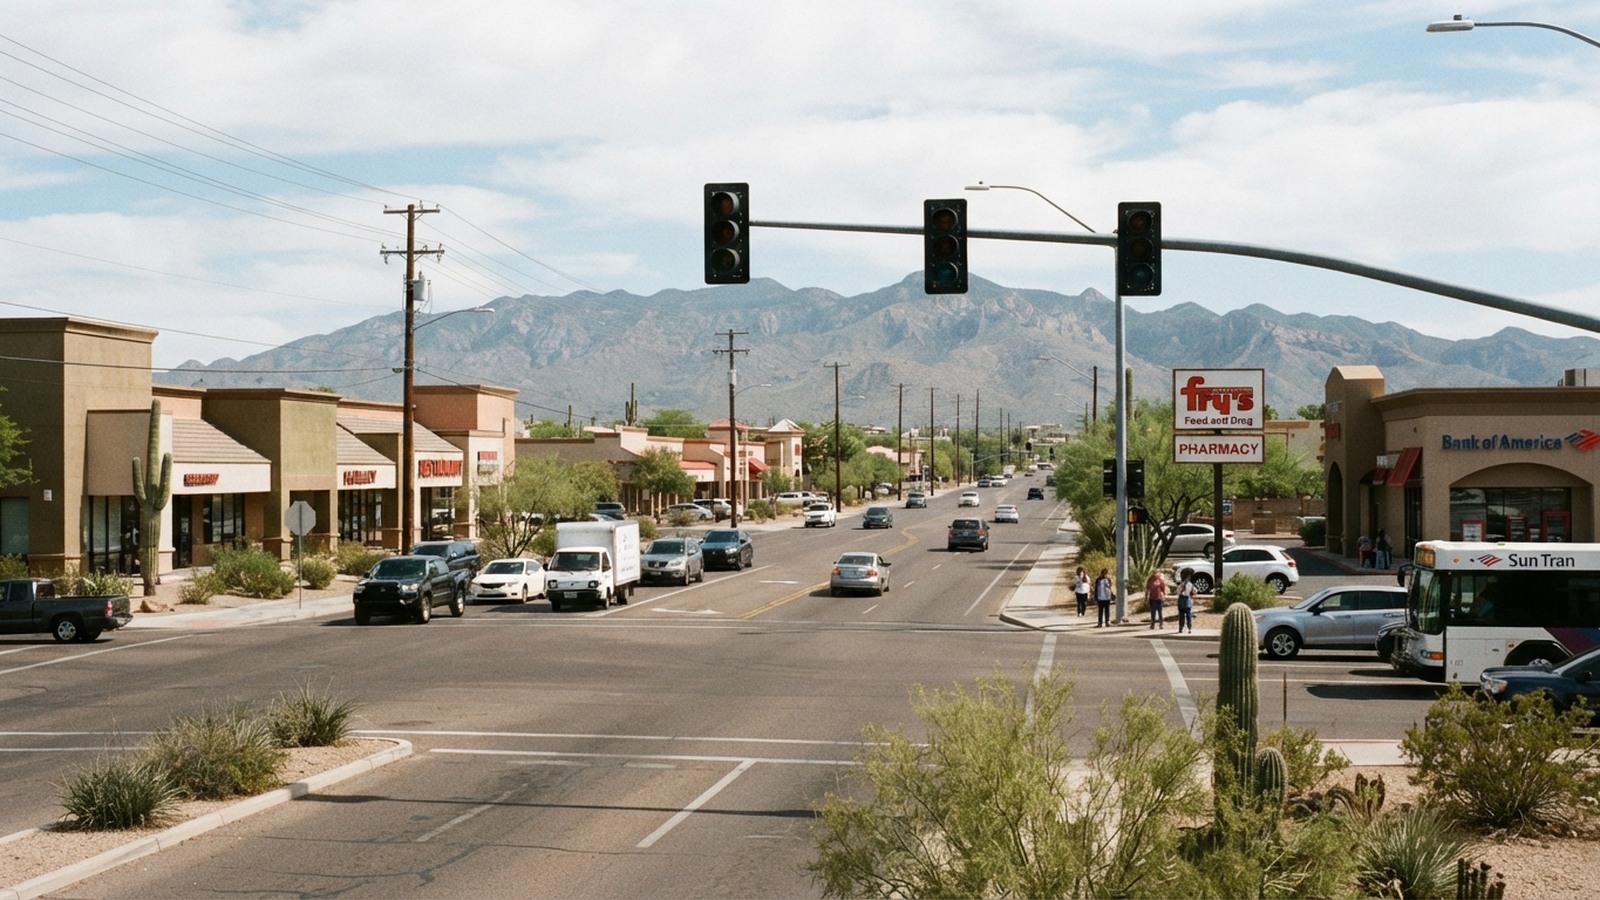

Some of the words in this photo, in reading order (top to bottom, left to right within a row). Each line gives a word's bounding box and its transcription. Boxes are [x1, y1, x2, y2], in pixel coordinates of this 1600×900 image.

[1180, 376, 1254, 415] fry's
[1184, 416, 1208, 425] Feed
[1179, 443, 1259, 455] PHARMACY
[1442, 434, 1480, 450] Bank
[1482, 434, 1498, 450] of
[1500, 434, 1562, 450] America
[1508, 553, 1538, 568] Sun
[1540, 553, 1575, 568] Tran
